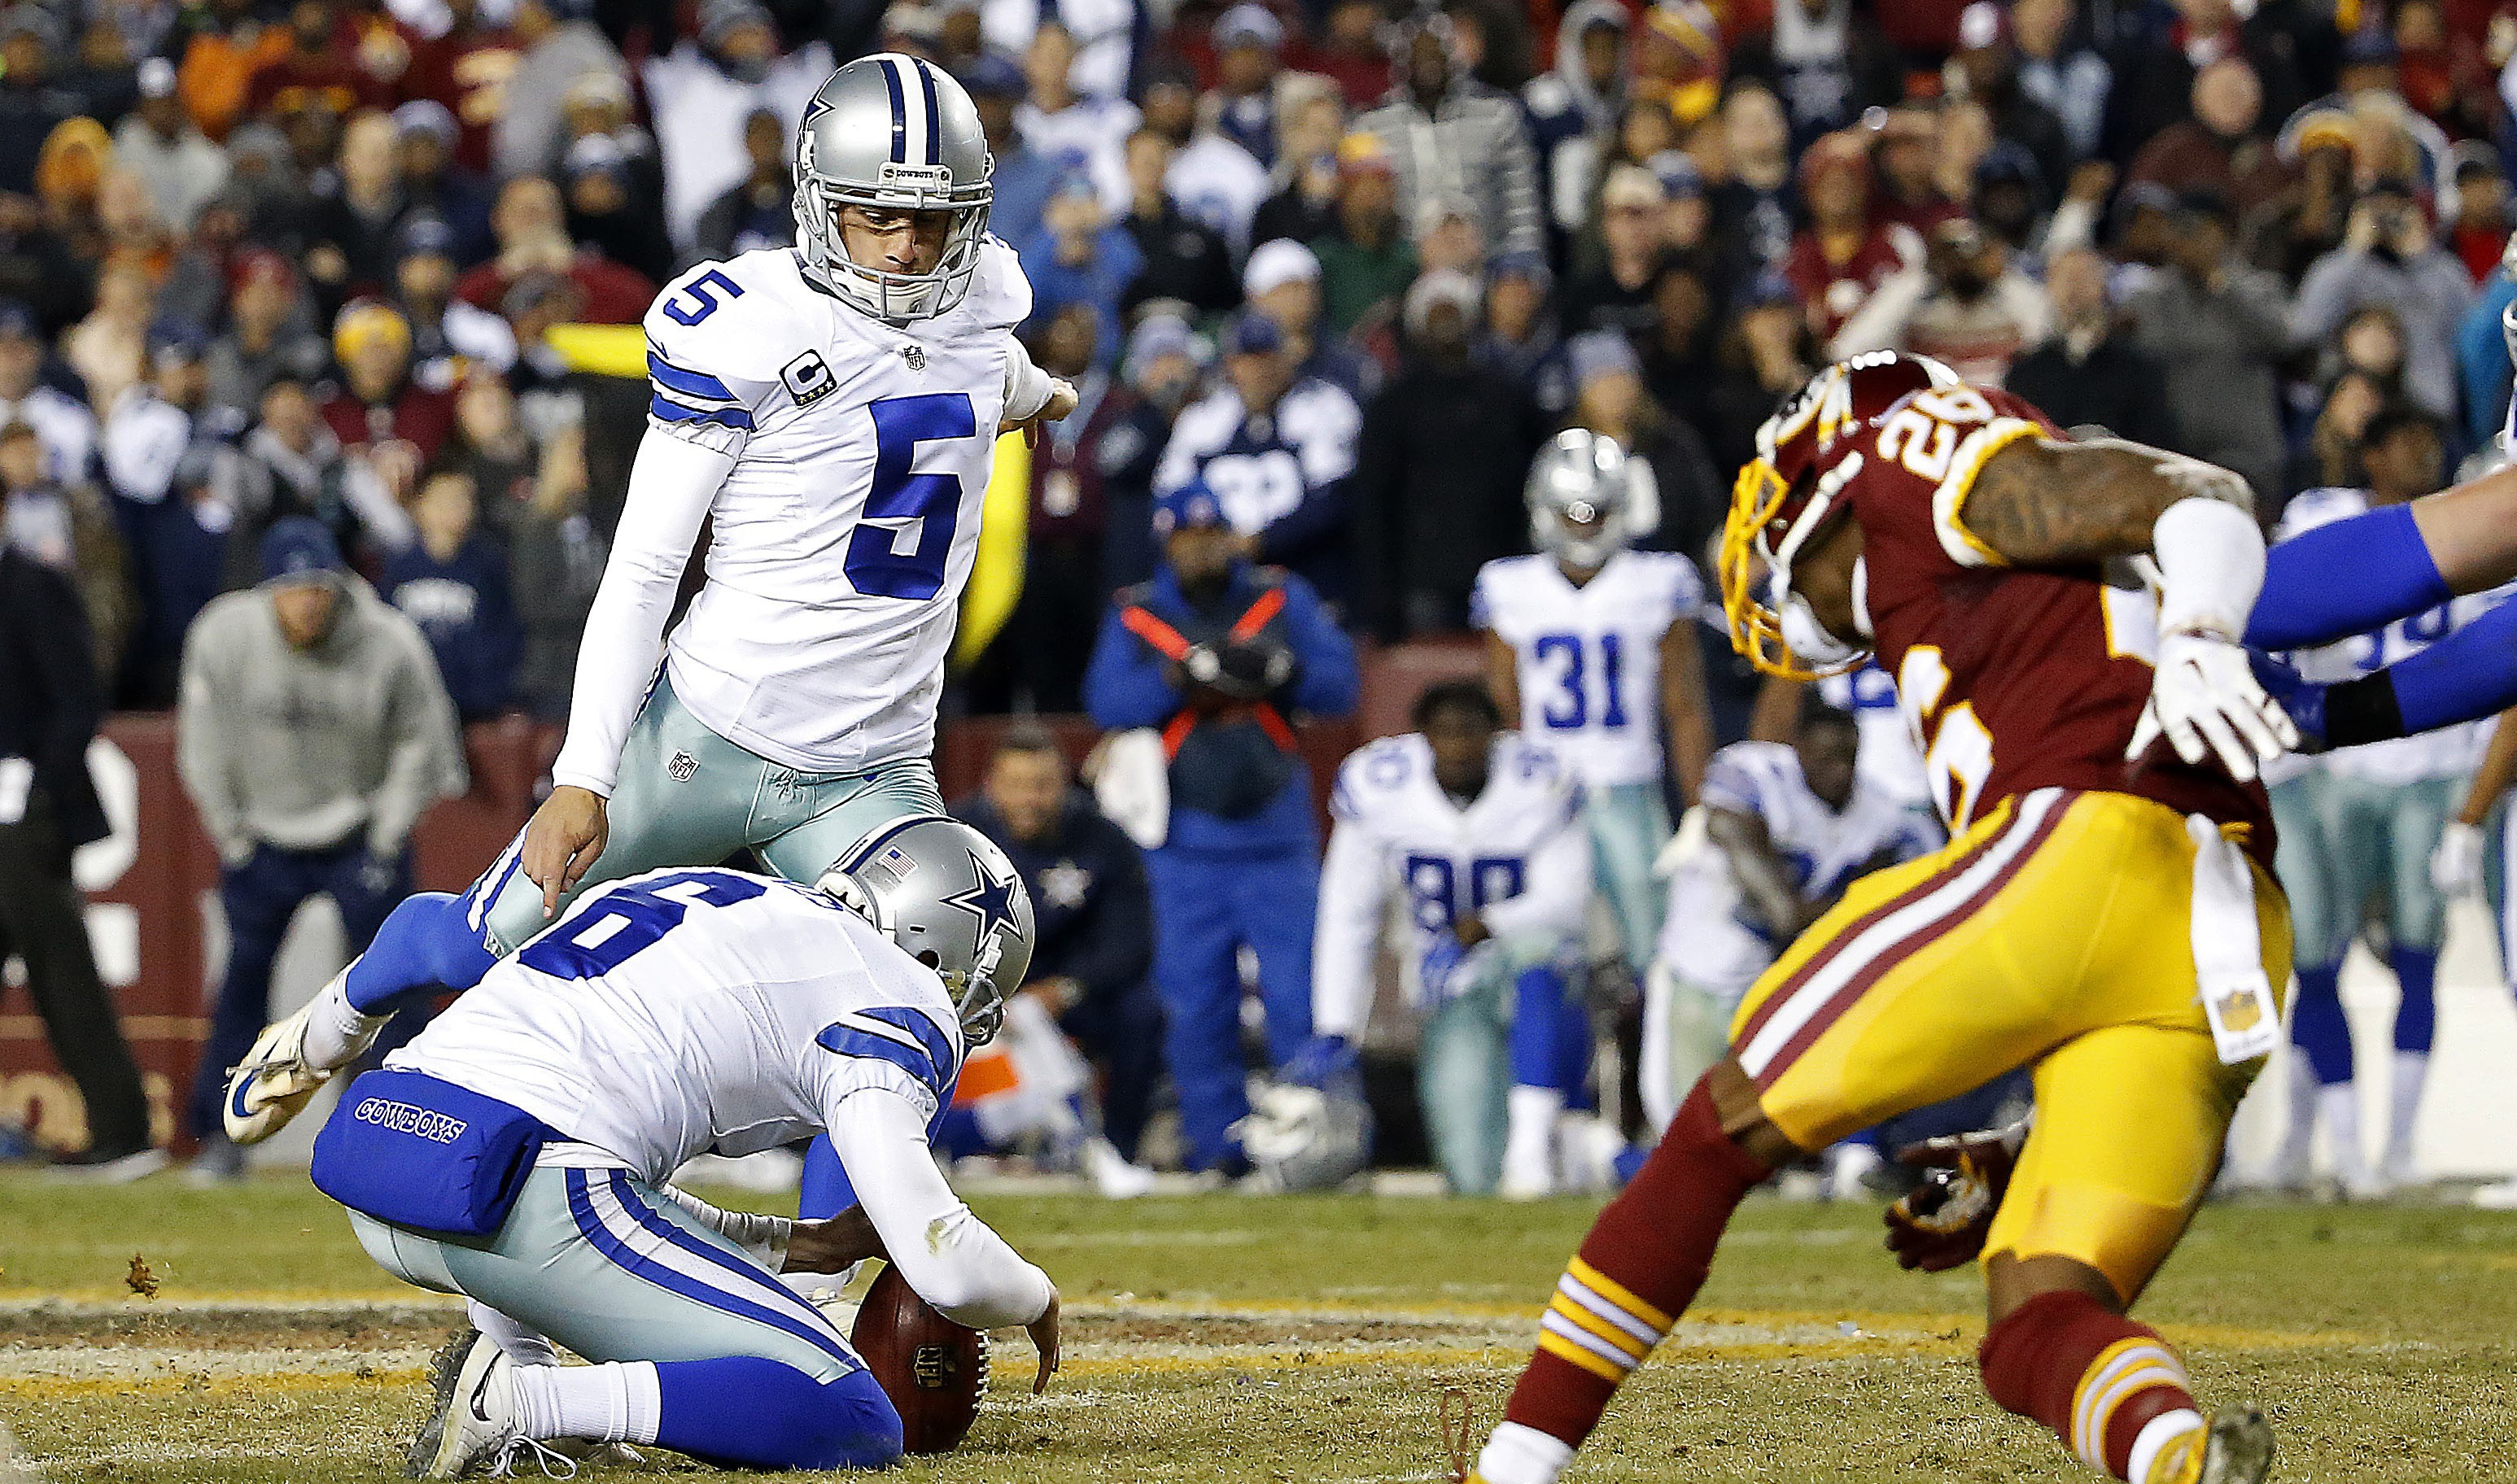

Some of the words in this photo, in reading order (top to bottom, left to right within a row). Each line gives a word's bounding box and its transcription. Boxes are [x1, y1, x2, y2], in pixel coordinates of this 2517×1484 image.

[663, 269, 745, 326] 5
[784, 352, 828, 395] C
[1875, 388, 1995, 483] 26
[843, 392, 977, 601] 5
[1536, 633, 1628, 729] 31
[517, 871, 768, 982] 6
[353, 1096, 469, 1145] COWBOYS
